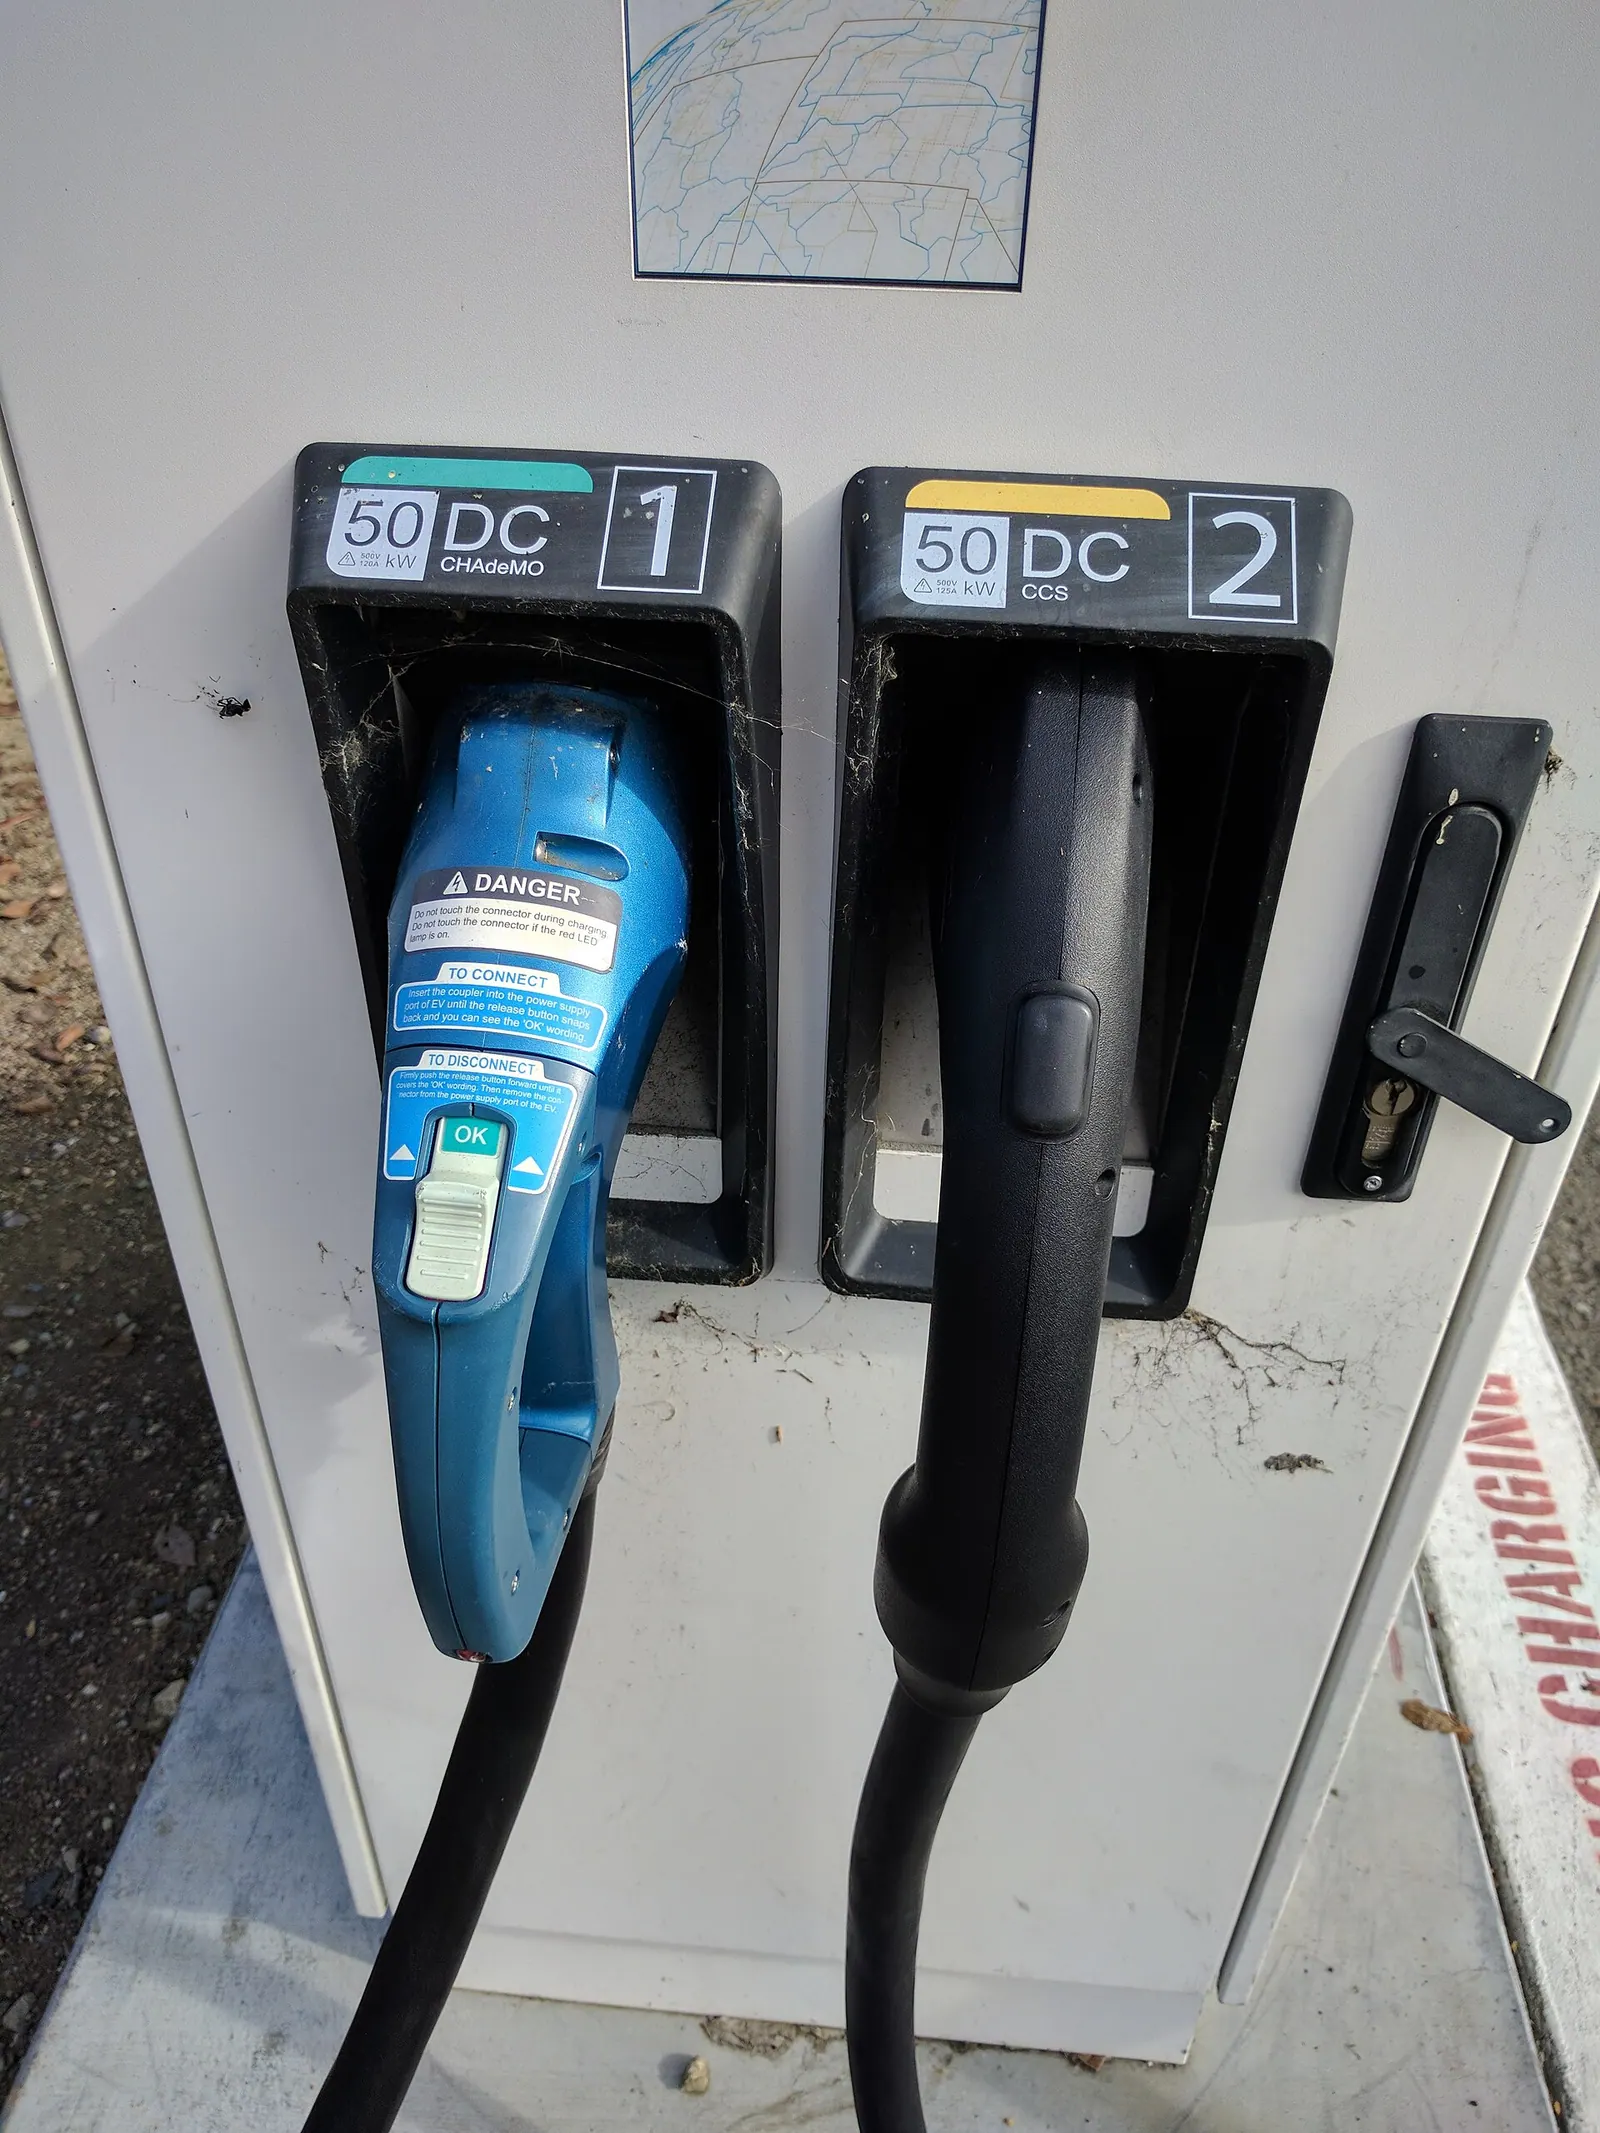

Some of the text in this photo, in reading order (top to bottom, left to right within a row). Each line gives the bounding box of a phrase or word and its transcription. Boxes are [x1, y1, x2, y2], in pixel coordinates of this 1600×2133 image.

[344, 499, 425, 548] 50
[443, 502, 550, 555] DC
[639, 484, 677, 577] 1
[385, 554, 417, 569] kW
[915, 525, 998, 576] 50
[1022, 528, 1130, 582] DC
[1208, 510, 1281, 607] 2
[440, 556, 545, 578] CHAdeMO
[936, 579, 958, 587] 500V
[964, 580, 996, 596] kW
[1021, 583, 1069, 602] CCS
[475, 873, 581, 906] DANGER
[414, 911, 424, 920] Do
[426, 908, 438, 917] not
[440, 905, 462, 914] touch
[466, 905, 480, 914] the
[482, 906, 532, 919] connector
[534, 912, 565, 926] during
[410, 933, 427, 943] lamp
[429, 932, 435, 940] is
[412, 917, 598, 946] Do not touch the connector if the red LED
[448, 968, 549, 988] TO CONNECT
[408, 987, 590, 1019] Insert the coupler into the power supply
[404, 999, 590, 1030] port of EV until the release button snaps
[403, 1012, 587, 1042] back and you can see the 'OK' wording.
[429, 1054, 536, 1075] TO DISCONNECT
[399, 1072, 419, 1080] Firmly
[420, 1072, 437, 1080] push
[452, 1073, 480, 1081] release
[481, 1075, 506, 1084] button
[508, 1077, 537, 1089] forward
[538, 1084, 555, 1093] until
[430, 1081, 446, 1089] 'OK'
[446, 1083, 478, 1093] wording.
[481, 1084, 501, 1093] Then
[502, 1088, 532, 1098] remove
[533, 1092, 546, 1101] the
[547, 1096, 565, 1104] con-
[450, 1093, 475, 1101] power
[475, 1095, 502, 1104] supply
[503, 1098, 519, 1106] port
[530, 1101, 543, 1110] the
[544, 1104, 557, 1113] EV.
[454, 1125, 489, 1145] OK
